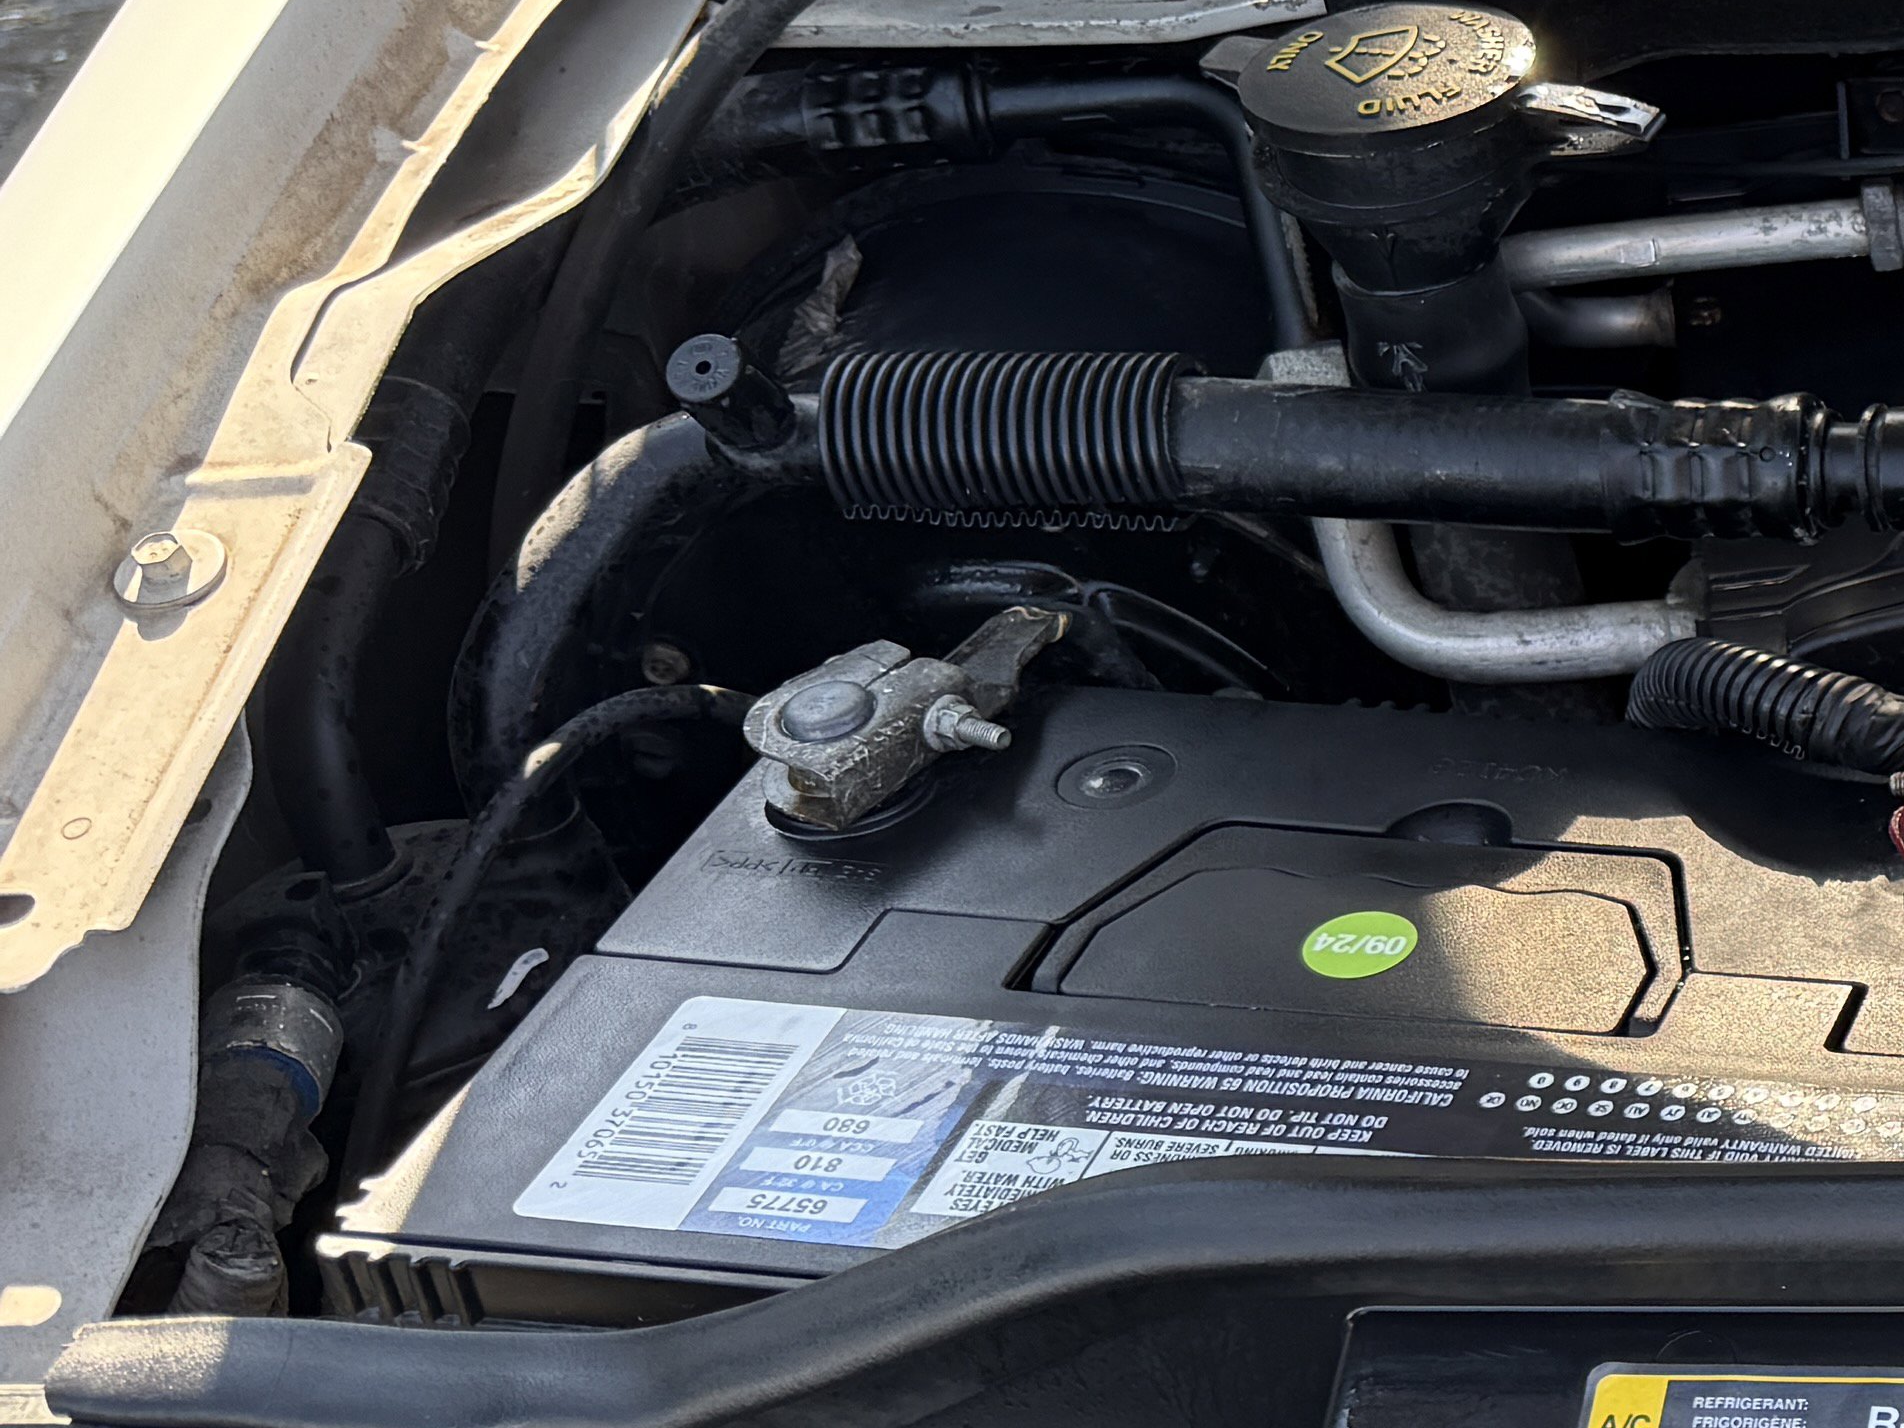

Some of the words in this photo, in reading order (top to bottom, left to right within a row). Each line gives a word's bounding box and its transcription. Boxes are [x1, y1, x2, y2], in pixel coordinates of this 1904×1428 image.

[1450, 11, 1505, 73] WASHER
[1267, 31, 1323, 71] ONLY
[1357, 84, 1460, 115] FLUID
[1312, 933, 1408, 955] 09/24
[626, 1054, 676, 1102] 10150
[1136, 1070, 1219, 1090] WARNING:
[1218, 1076, 1243, 1091] 65
[1241, 1078, 1356, 1099] PROPOSITION
[1354, 1085, 1454, 1107] CALIFORNIA
[1087, 1094, 1168, 1113] BATTERY.
[1165, 1101, 1216, 1117] OPEN
[1084, 1109, 1174, 1129] CHILDREN.
[1214, 1105, 1255, 1120] NOT
[1254, 1107, 1284, 1121] DO
[1288, 1109, 1319, 1124] TIP.
[1319, 1112, 1360, 1127] NOT
[821, 1116, 871, 1135] 680
[1172, 1116, 1200, 1131] OF
[1199, 1118, 1262, 1135] REACH
[1359, 1114, 1389, 1129] DO
[577, 1106, 633, 1161] 37065
[972, 1122, 1017, 1139] FAST.
[1015, 1126, 1061, 1143] HELP
[1259, 1123, 1287, 1137] OF
[1286, 1124, 1326, 1140] OUT
[1325, 1127, 1373, 1143] KEEP
[966, 1136, 1040, 1155] MEDICAL
[1114, 1136, 1166, 1151] BURNS.
[1164, 1140, 1220, 1155] SEVERE
[1532, 1139, 1603, 1155] REMOVED.
[1605, 1143, 1623, 1156] IS
[1625, 1144, 1669, 1158] LABEL
[952, 1148, 990, 1165] GET
[1670, 1146, 1704, 1160] THIS
[792, 1154, 844, 1173] 810
[961, 1169, 1020, 1187] WATER.
[745, 1192, 829, 1215] 65775
[738, 1216, 767, 1229] NO.
[767, 1219, 812, 1233] PART
[1691, 1395, 1809, 1411] REFRIGERANT:
